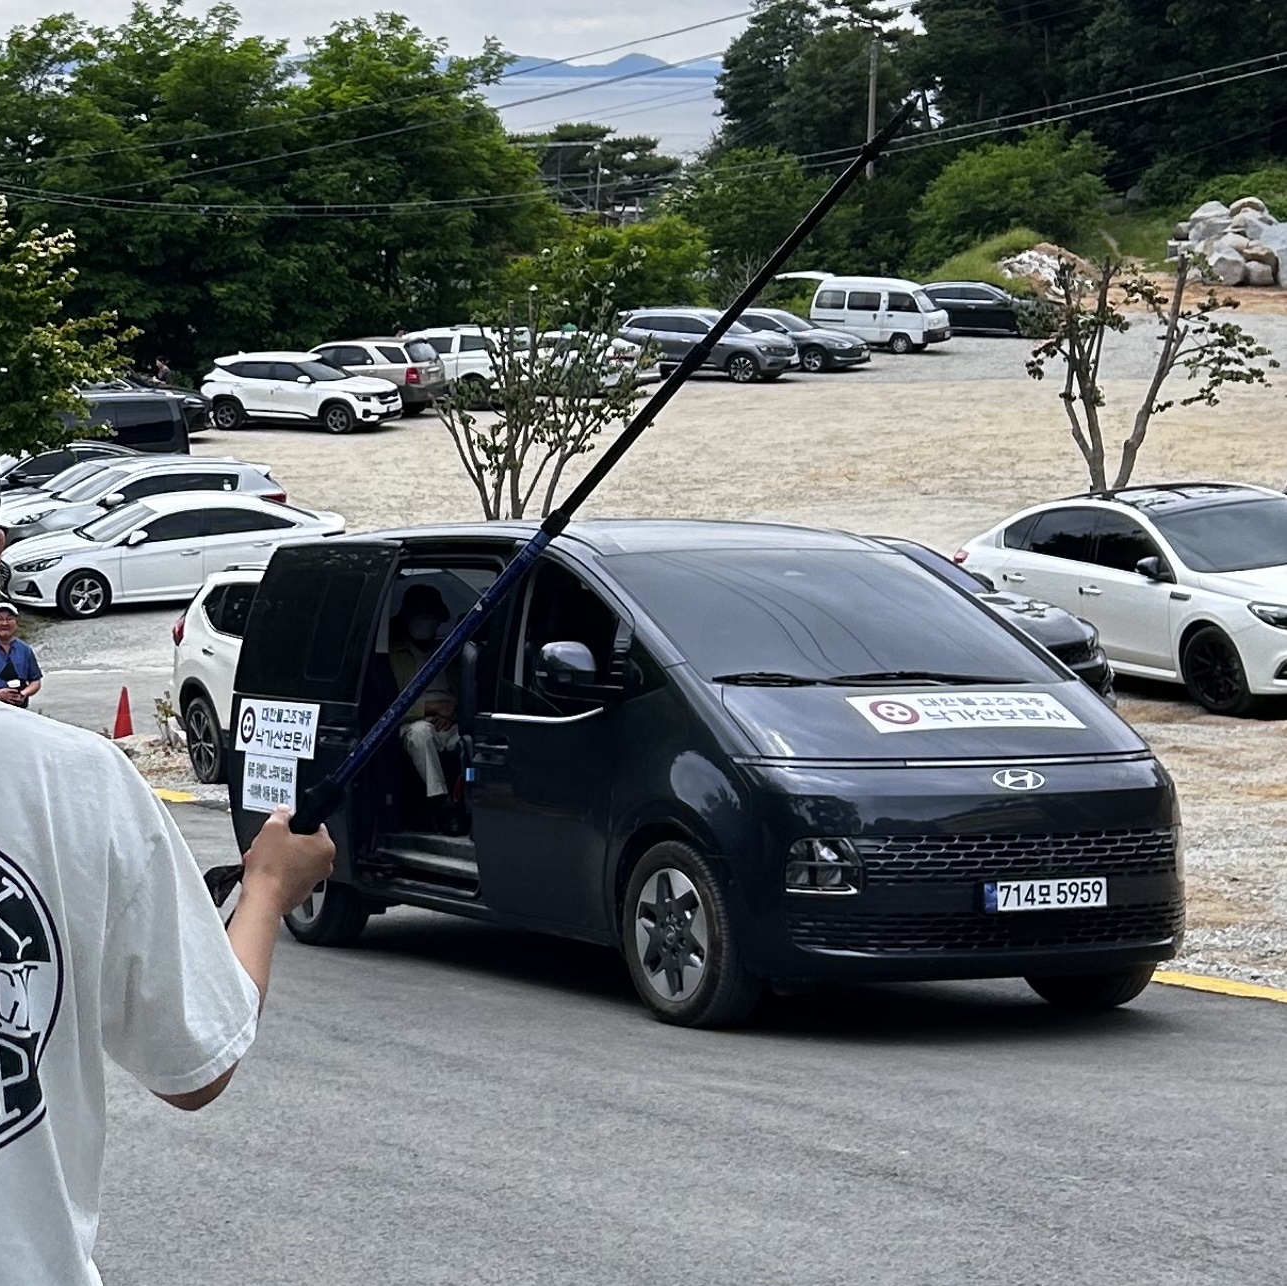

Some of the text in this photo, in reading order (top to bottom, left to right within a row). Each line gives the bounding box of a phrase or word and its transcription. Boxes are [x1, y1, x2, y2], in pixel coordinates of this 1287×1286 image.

[255, 728, 312, 752] 낙가산보문사
[999, 880, 1103, 907] 714모 5959
